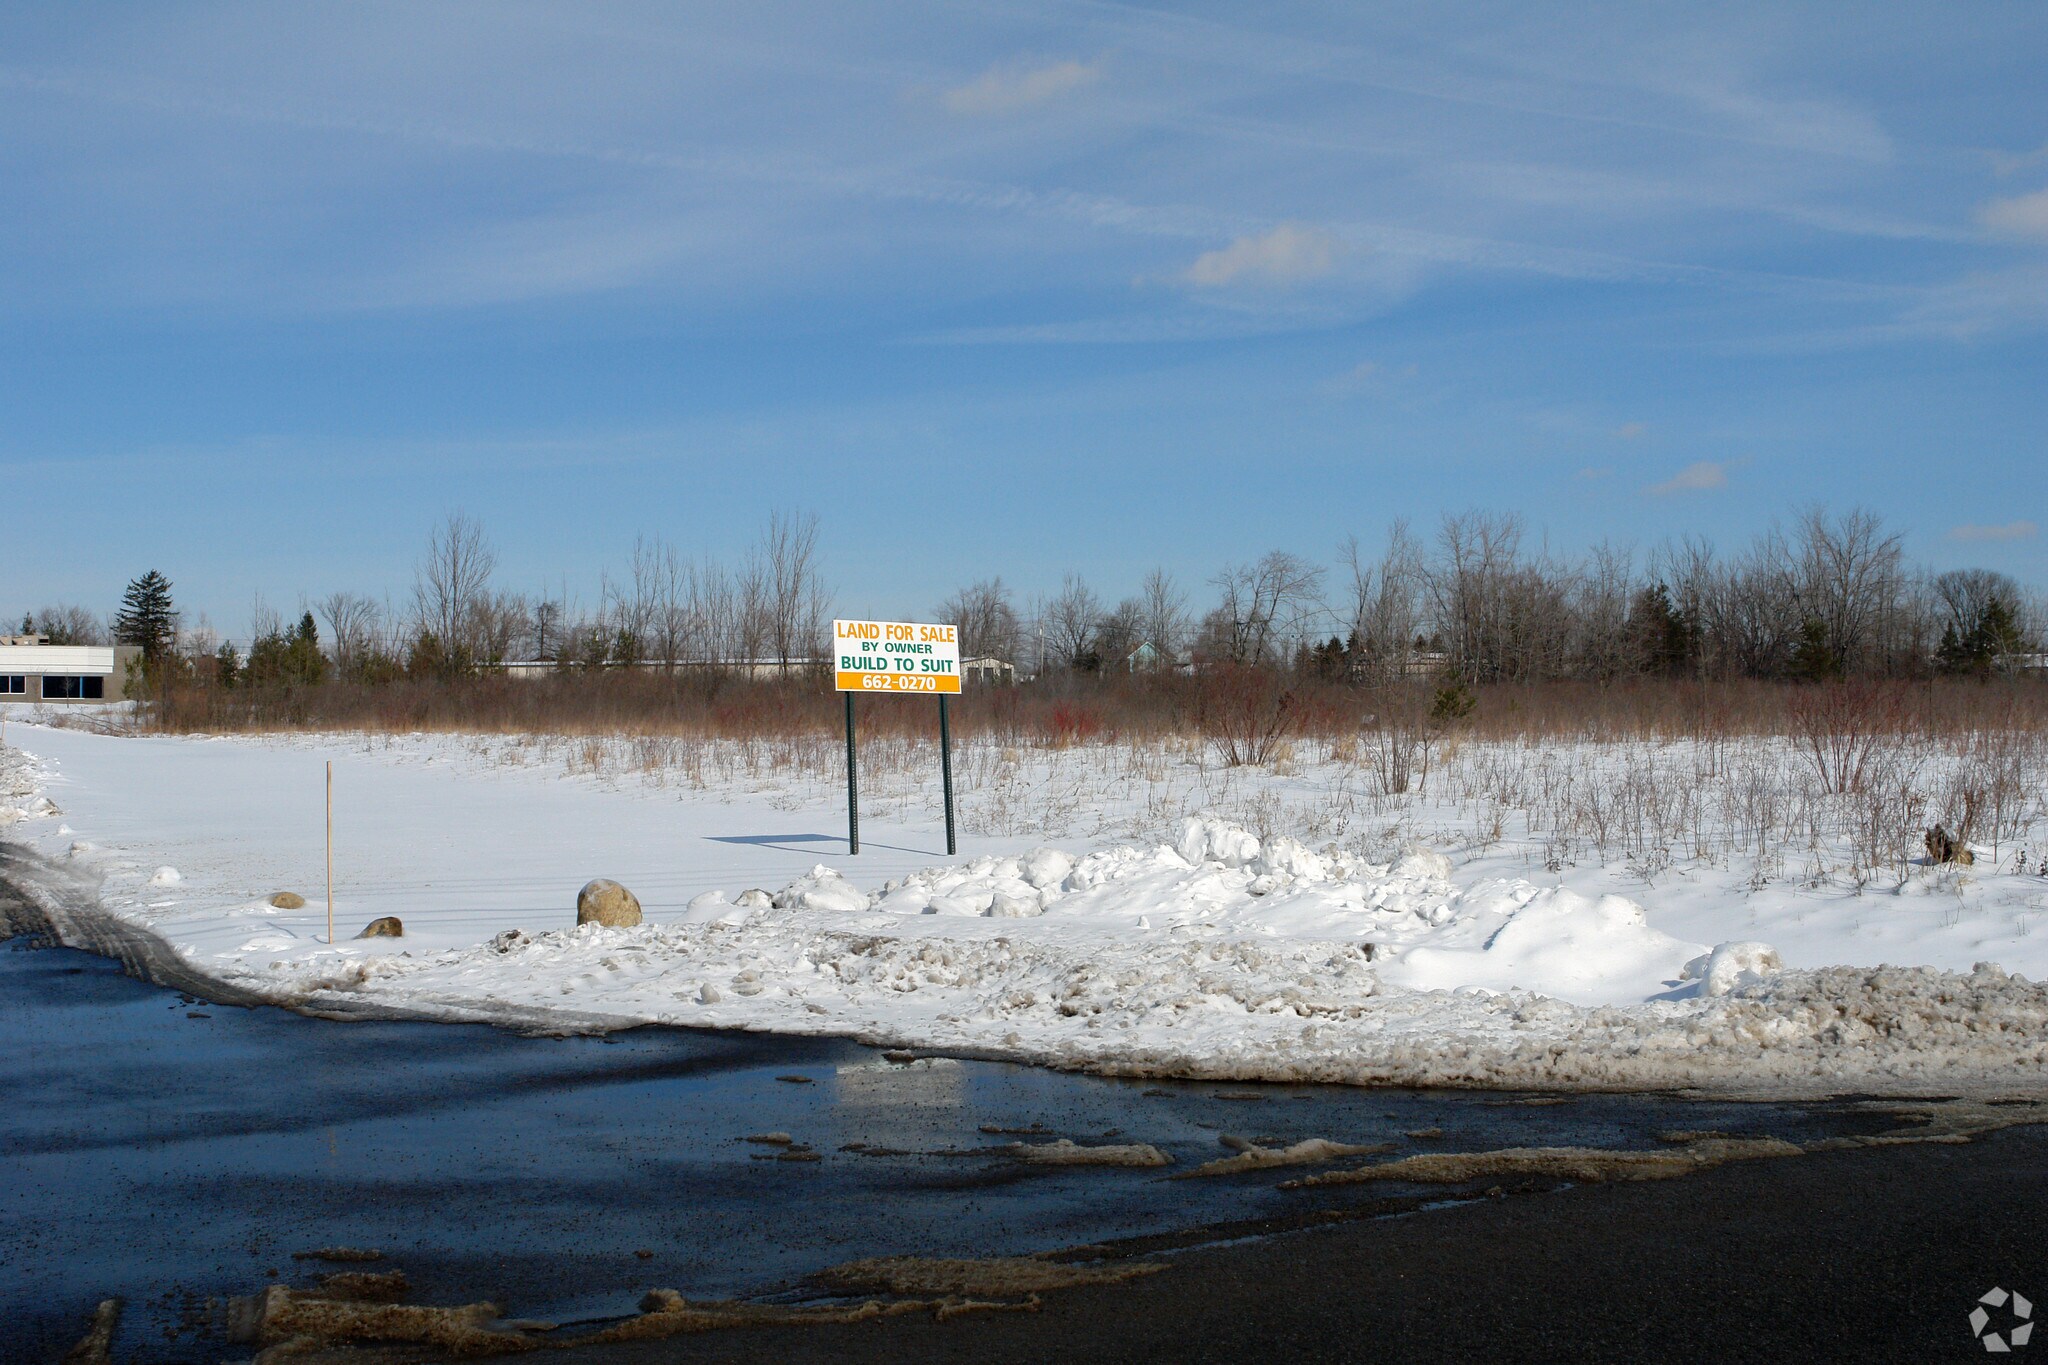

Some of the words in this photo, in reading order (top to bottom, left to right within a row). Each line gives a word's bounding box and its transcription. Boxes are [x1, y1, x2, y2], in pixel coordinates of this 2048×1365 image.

[837, 622, 880, 640] LAND
[886, 624, 914, 641] FOR
[920, 626, 955, 643] SALE
[862, 641, 879, 652] BY
[884, 642, 933, 654] OWNER
[841, 656, 888, 670] BUILD
[894, 657, 914, 671] TO
[921, 659, 953, 673] SUIT
[862, 675, 936, 690] 662-0270
